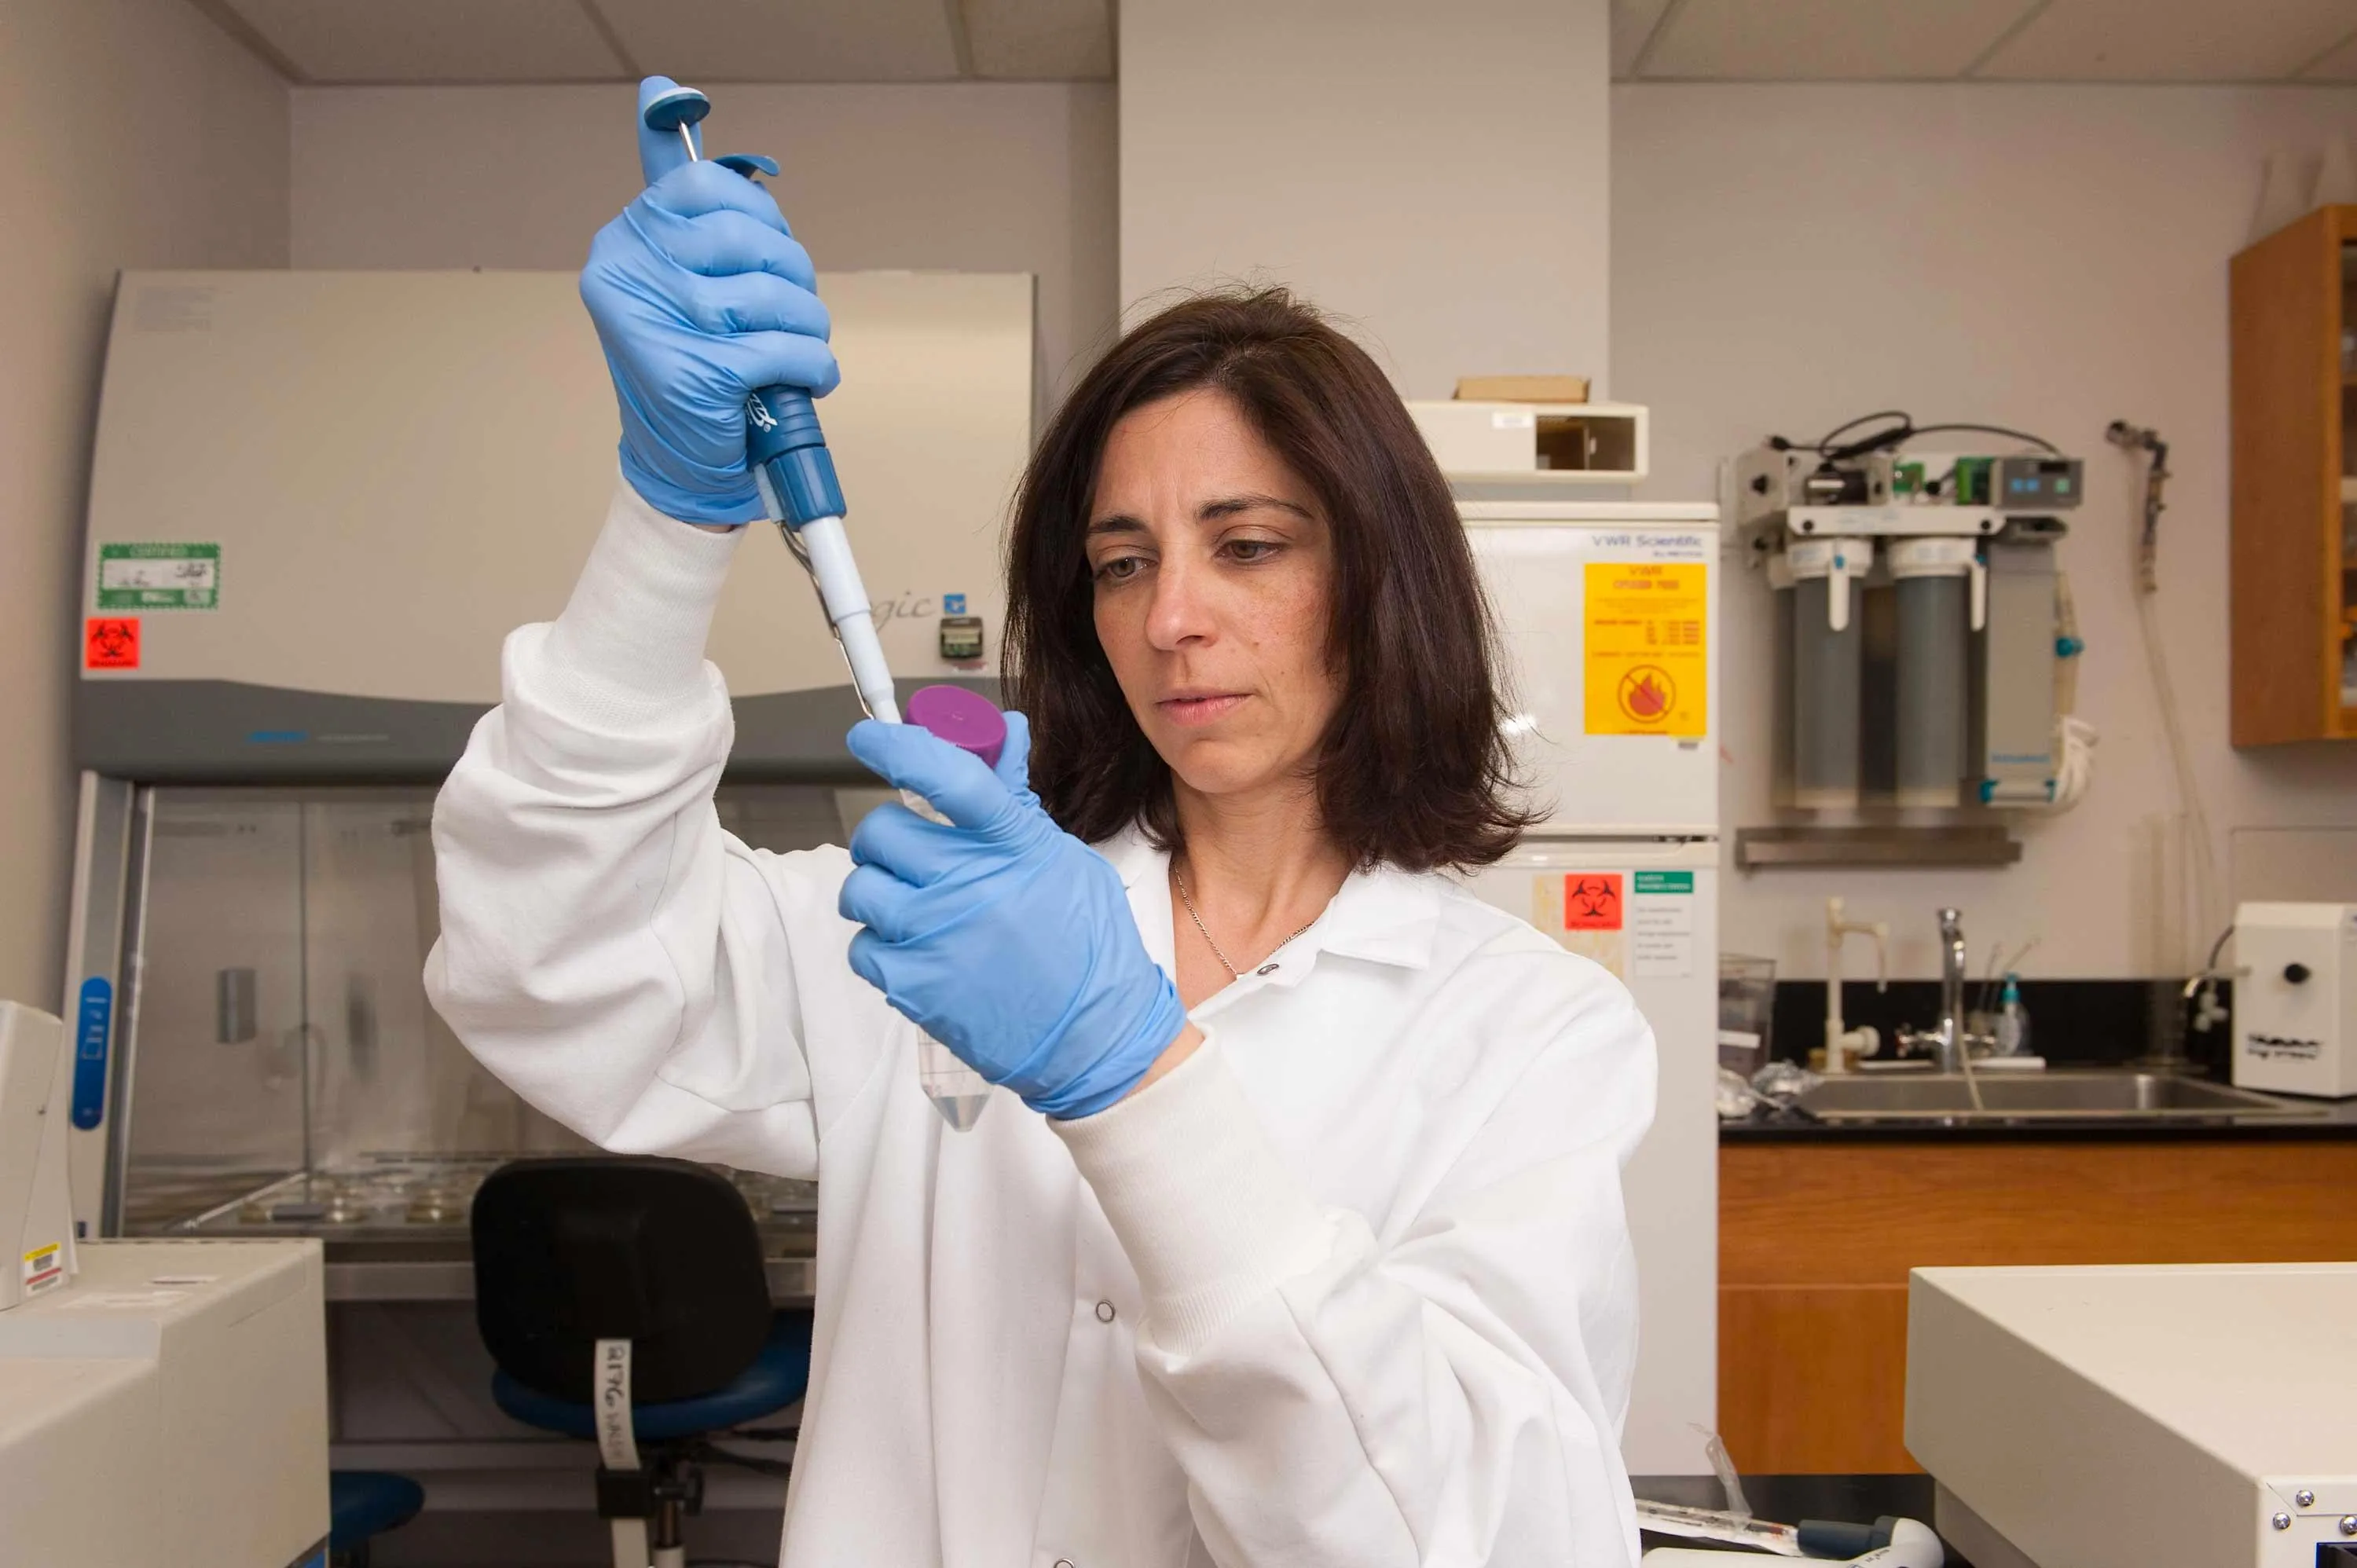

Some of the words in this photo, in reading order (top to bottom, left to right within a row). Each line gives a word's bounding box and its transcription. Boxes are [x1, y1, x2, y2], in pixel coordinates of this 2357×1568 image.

[1591, 535, 1631, 547] VWR
[1636, 535, 1703, 548] Scientific
[870, 588, 937, 635] gic
